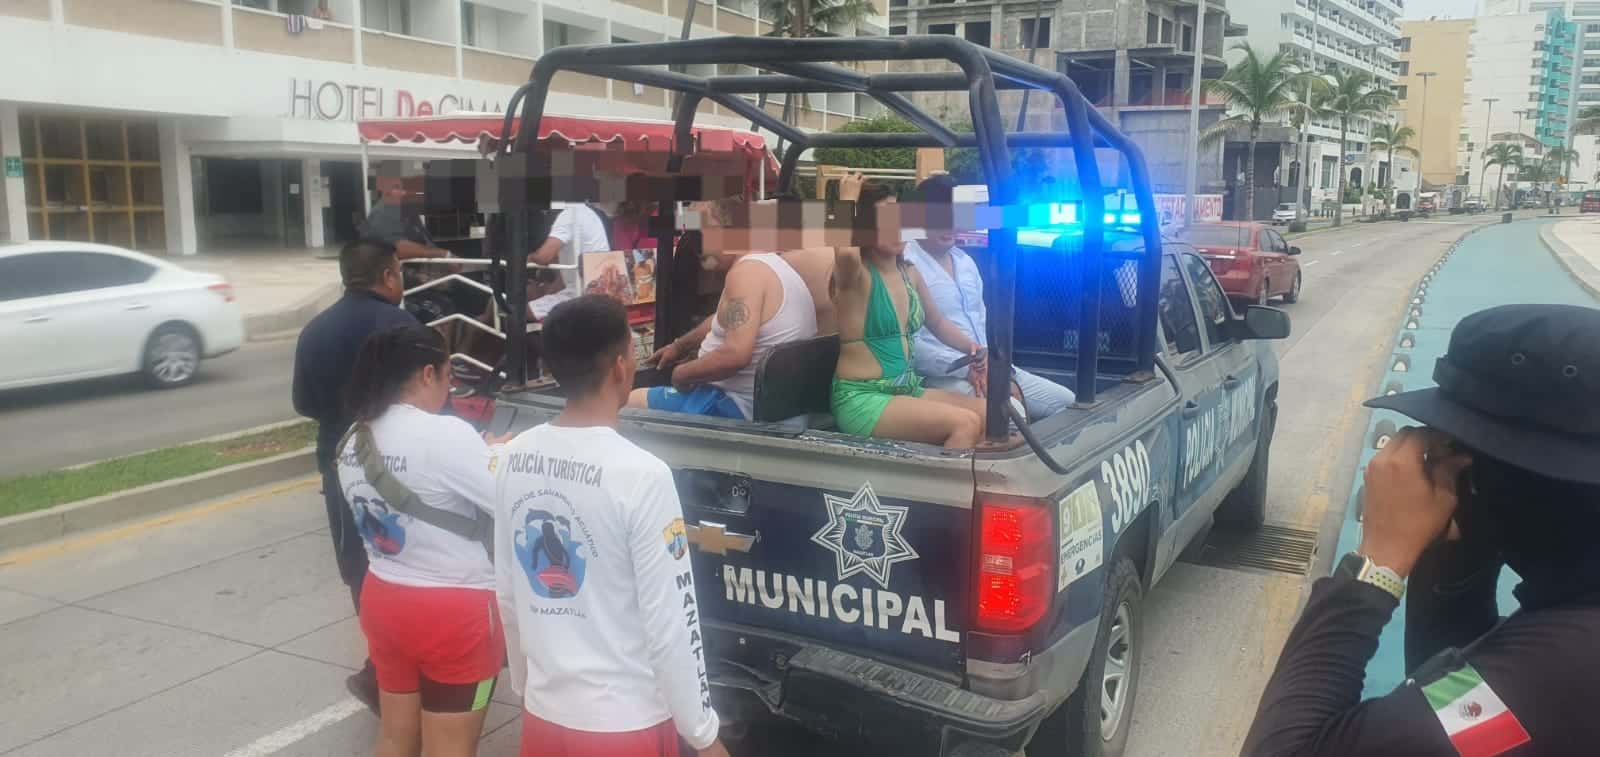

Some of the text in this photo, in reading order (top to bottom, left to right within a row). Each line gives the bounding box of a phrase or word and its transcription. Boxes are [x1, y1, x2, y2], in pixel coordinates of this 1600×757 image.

[395, 89, 433, 116] De
[547, 455, 604, 488] TURÍSTICA
[1101, 439, 1150, 534] 3890
[723, 564, 961, 643] MUNICIPAL
